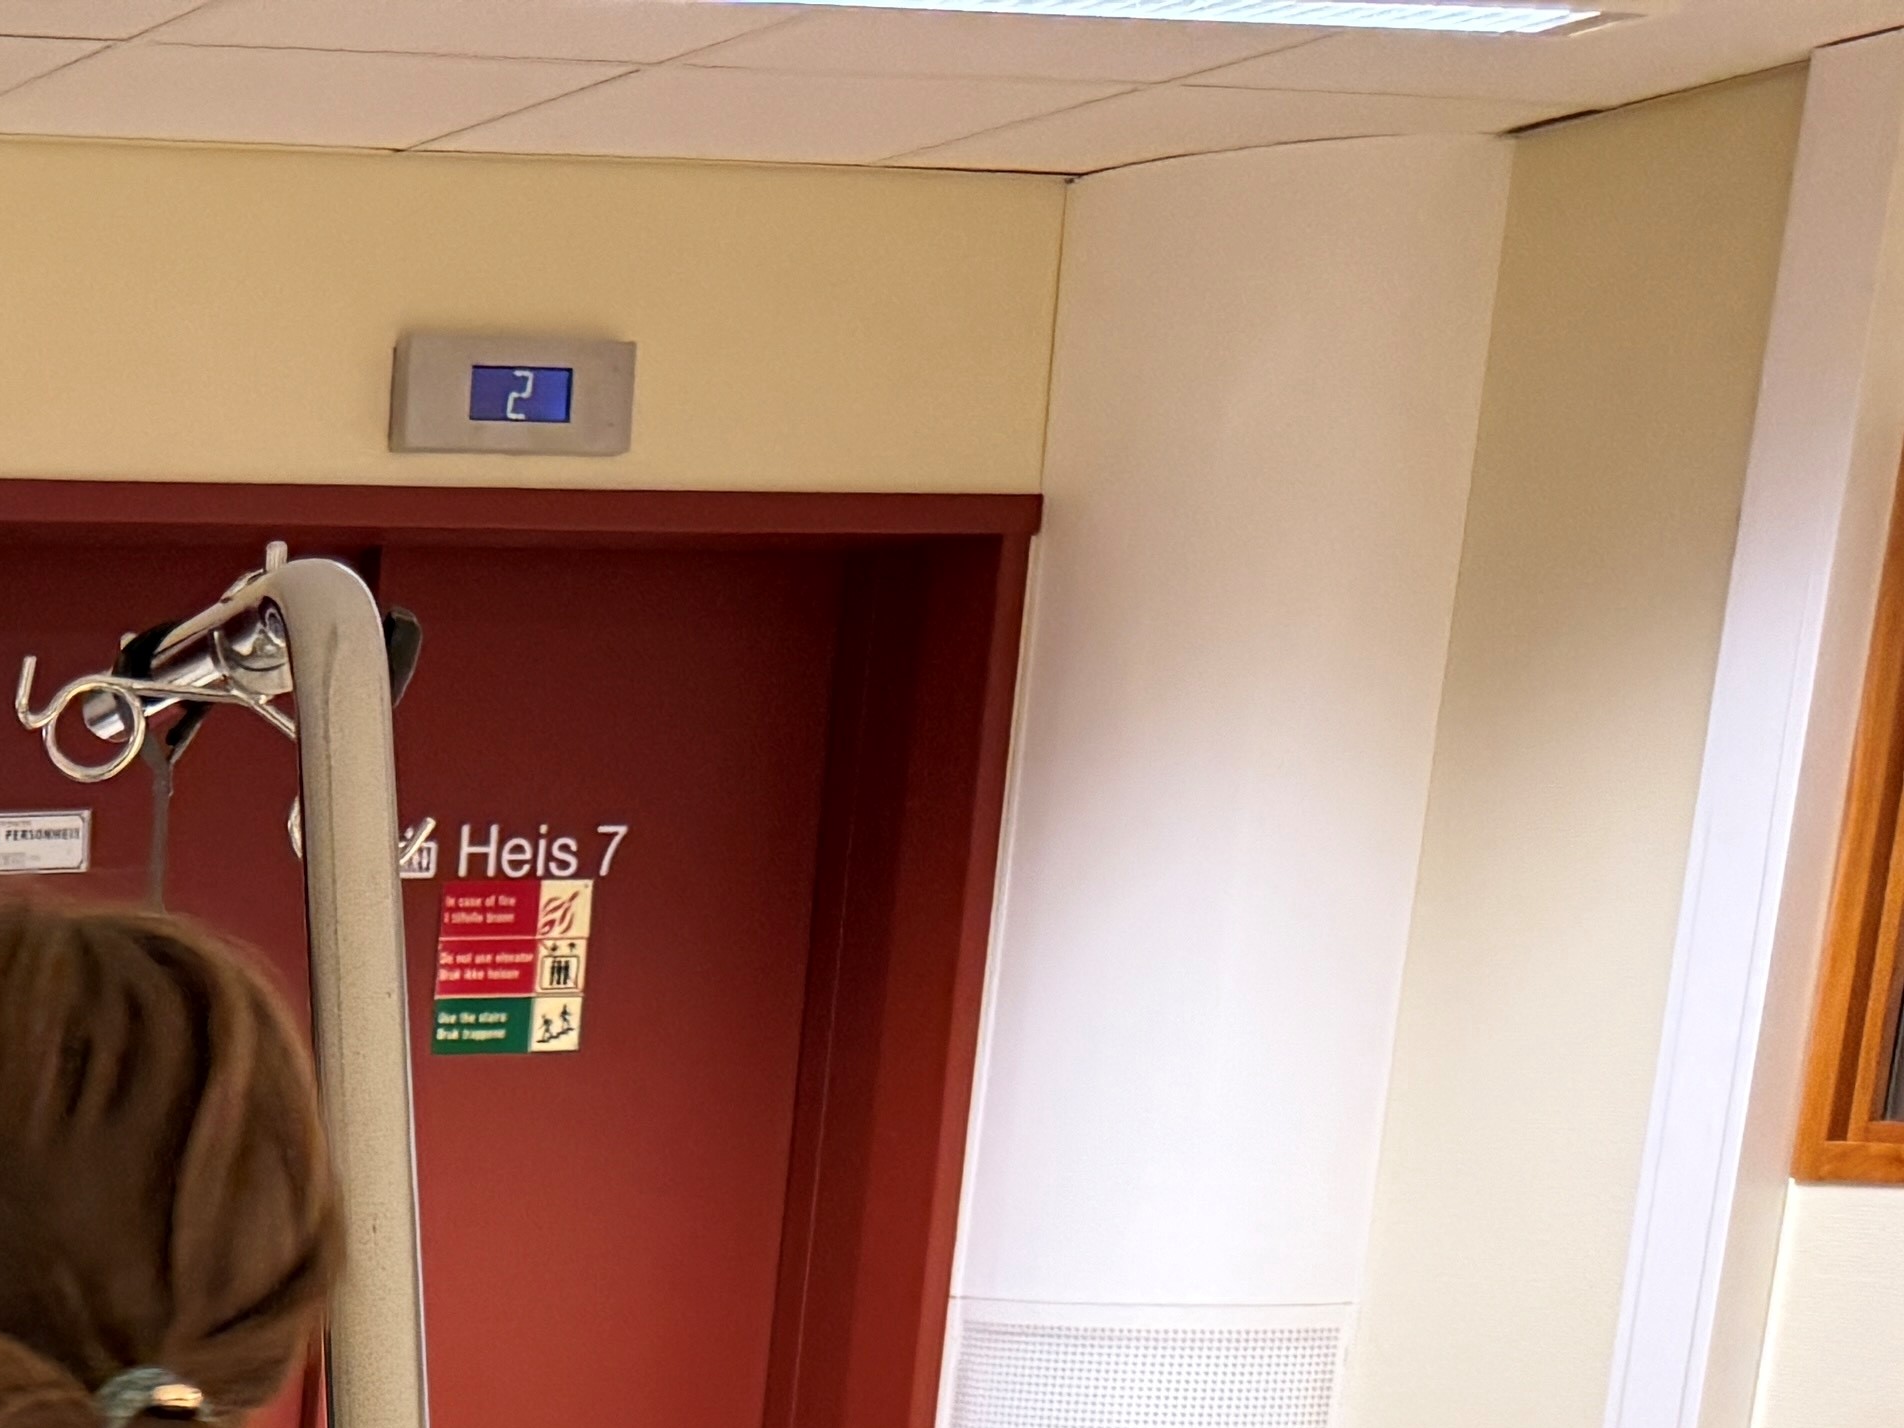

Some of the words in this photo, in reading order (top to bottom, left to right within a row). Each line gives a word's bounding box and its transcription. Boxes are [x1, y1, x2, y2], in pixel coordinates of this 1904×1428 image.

[506, 370, 534, 420] 2
[457, 823, 579, 877] Heis
[597, 825, 628, 876] 7
